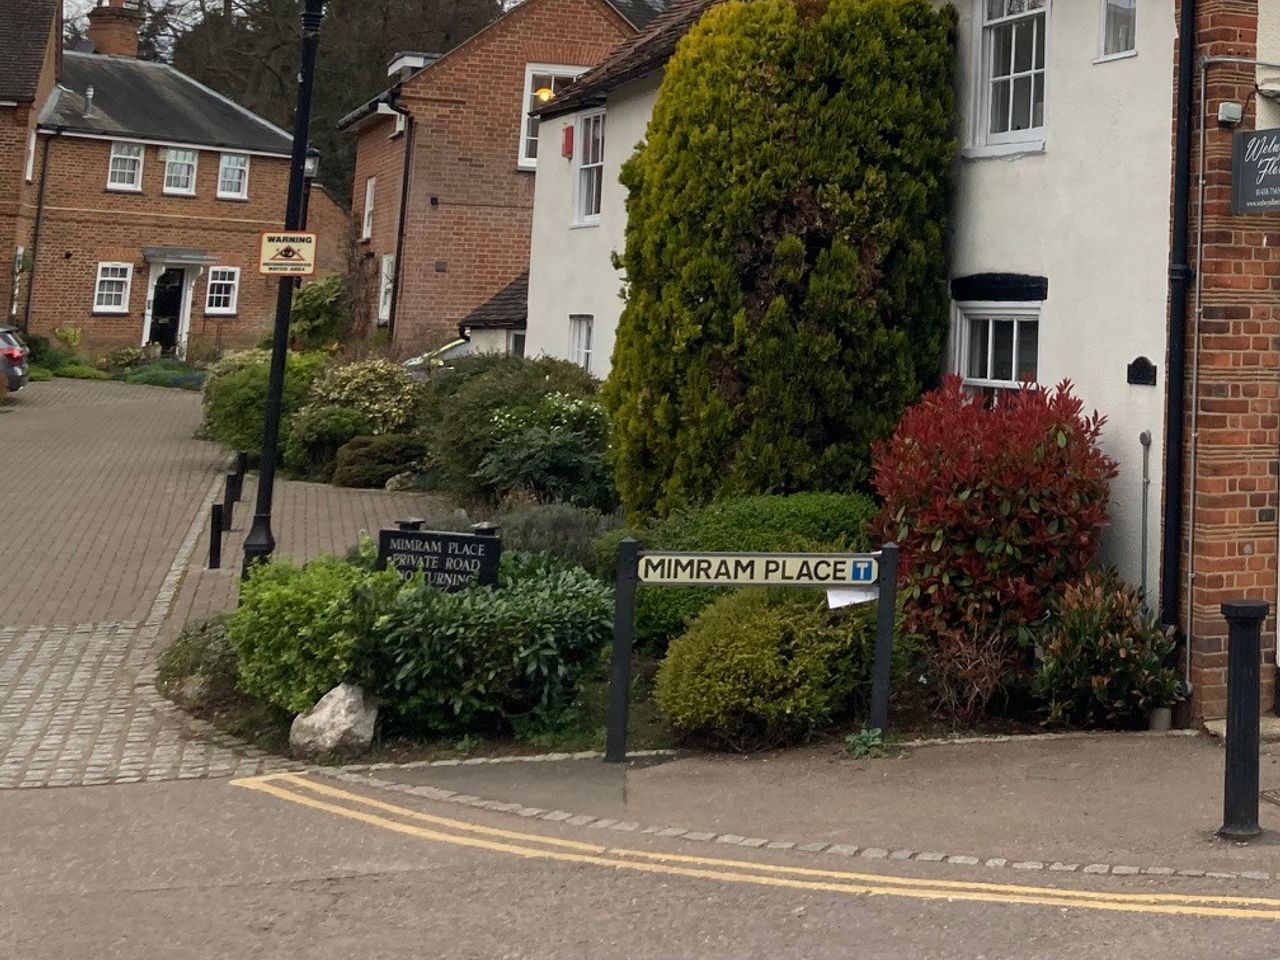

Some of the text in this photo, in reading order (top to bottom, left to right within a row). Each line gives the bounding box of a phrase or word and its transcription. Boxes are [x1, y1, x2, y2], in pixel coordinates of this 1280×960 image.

[267, 236, 313, 244] WARNING
[389, 539, 486, 556] MIMRAM PLACE
[392, 554, 480, 572] PRIVATE ROAD
[644, 558, 847, 581] MIMRAM PLACE
